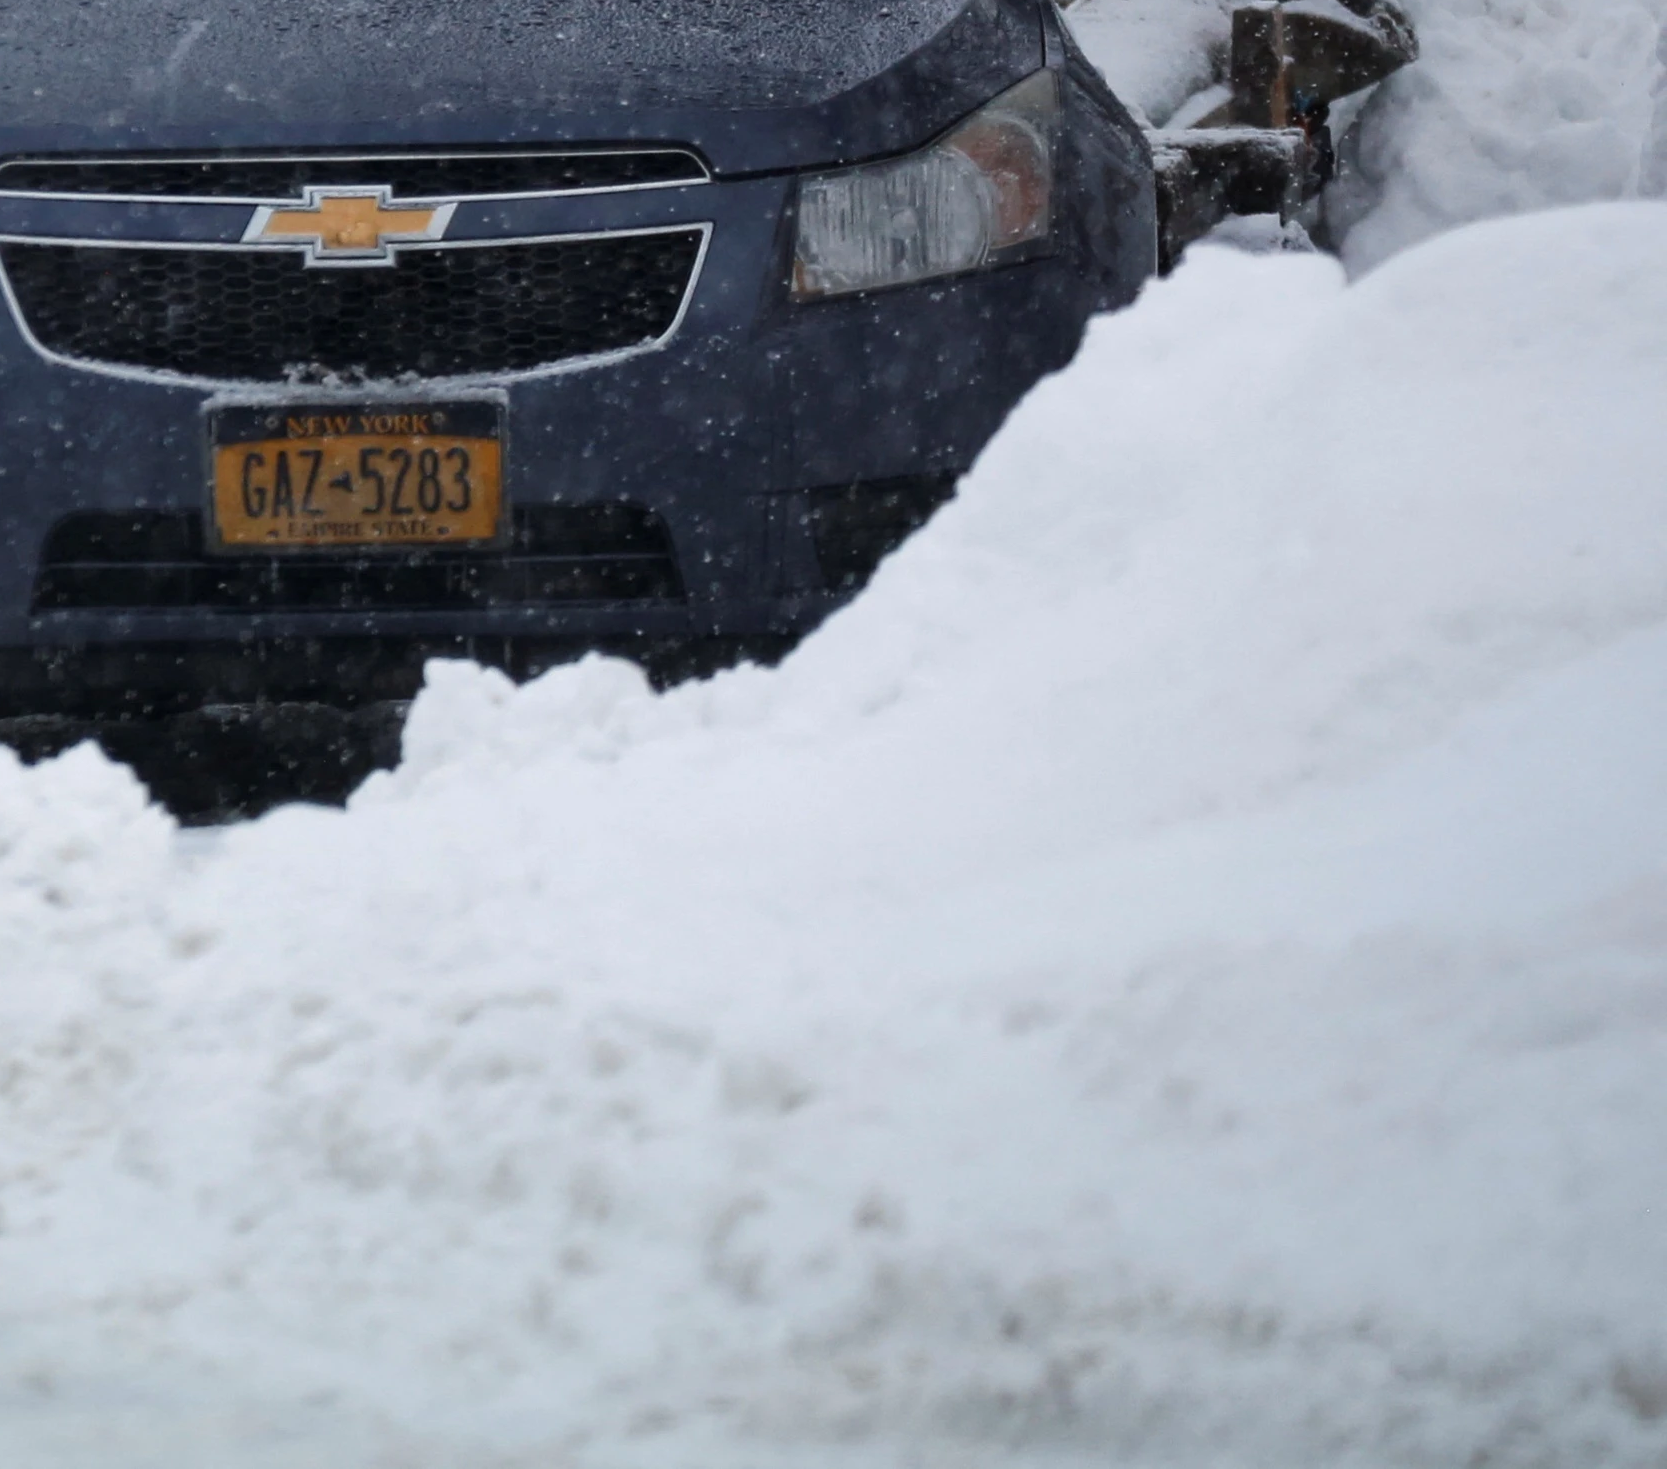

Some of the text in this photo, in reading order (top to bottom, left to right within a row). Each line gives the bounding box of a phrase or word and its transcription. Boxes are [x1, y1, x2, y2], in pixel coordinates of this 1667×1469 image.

[286, 414, 430, 434] NEW YORK
[241, 447, 472, 518] GAZ 5283
